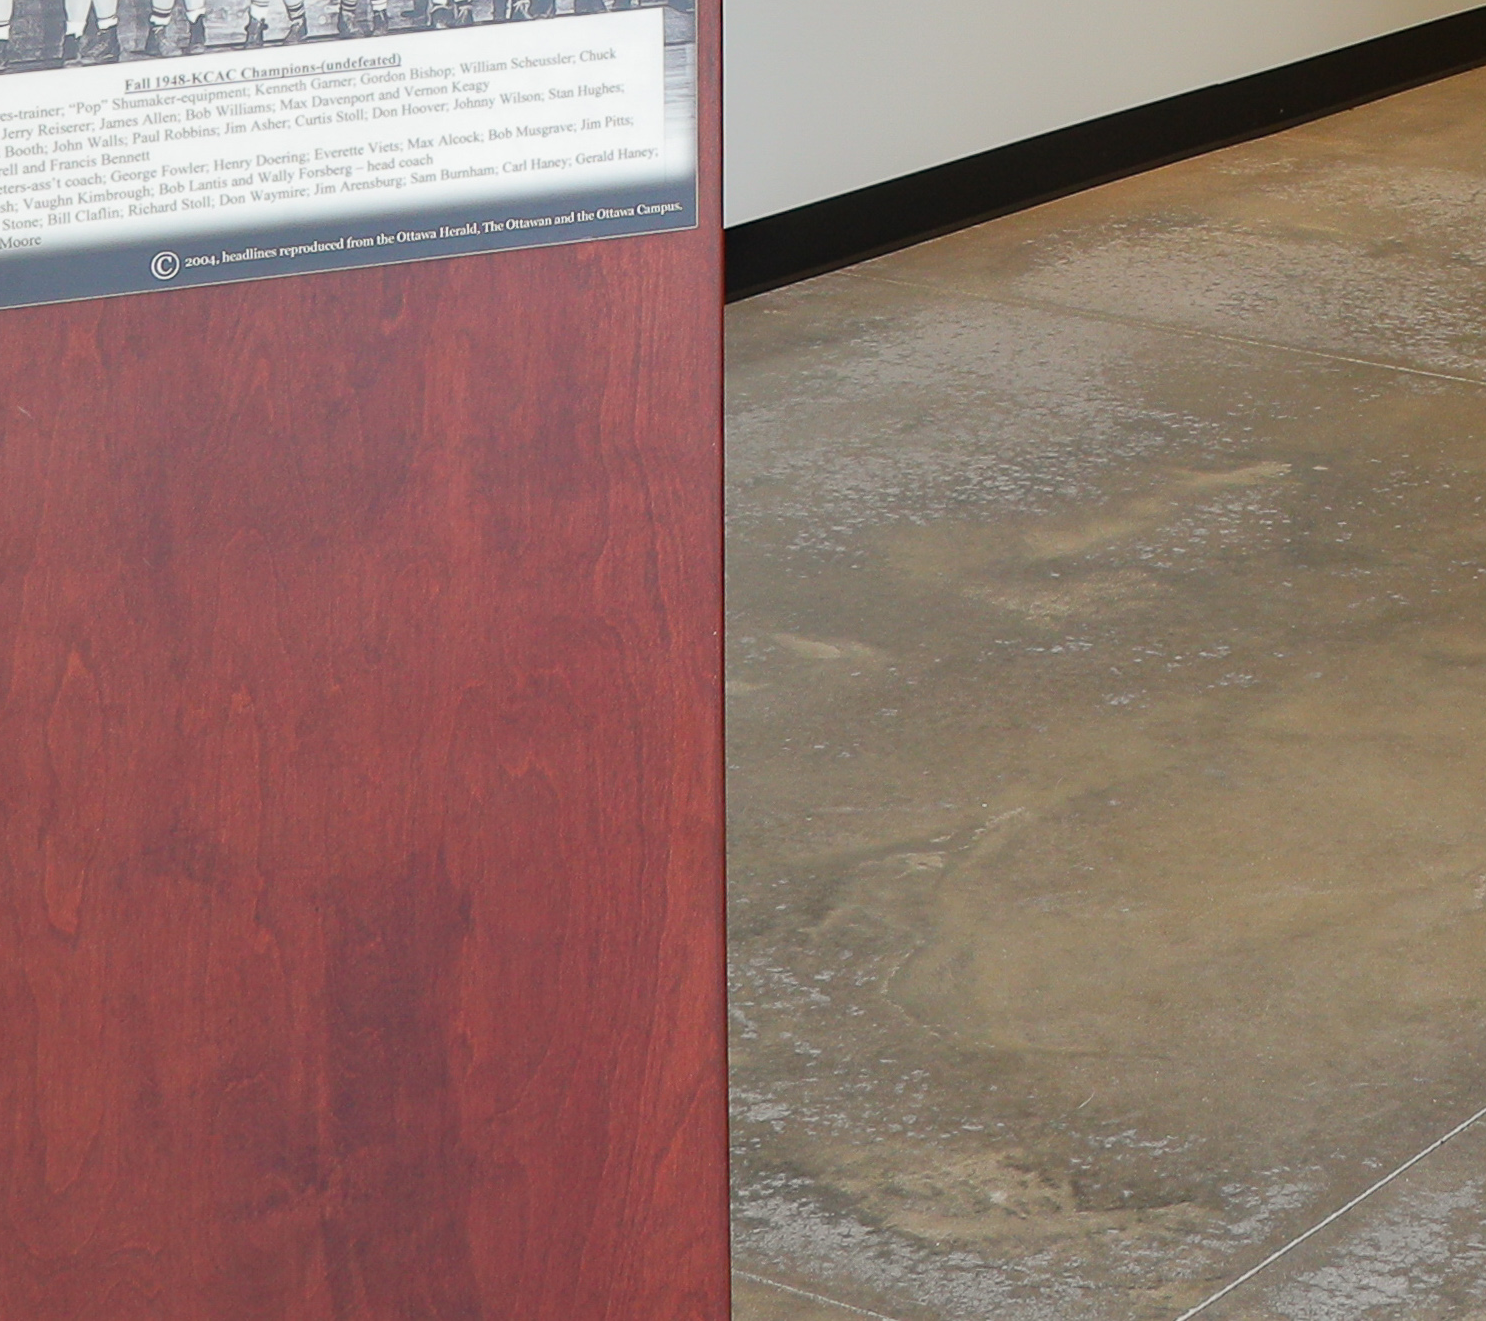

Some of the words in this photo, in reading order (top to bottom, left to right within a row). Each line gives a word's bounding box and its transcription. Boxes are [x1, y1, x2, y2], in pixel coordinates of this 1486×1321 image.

[125, 77, 151, 93] Fall
[155, 69, 237, 89] 1948-KCAC
[240, 53, 401, 81] Champions-(undefeated)
[184, 250, 220, 270] 2004,
[222, 244, 276, 263] headlines
[279, 236, 344, 260] reproduced
[346, 233, 374, 249] from
[376, 231, 394, 246] the
[396, 226, 436, 244] Ottawa
[439, 221, 481, 242] Herald,
[482, 218, 505, 234] The
[505, 213, 552, 232] Ottawan
[554, 210, 574, 226] and
[576, 208, 594, 224] the
[596, 204, 634, 221] Ottawa
[636, 198, 682, 220] Campus.
